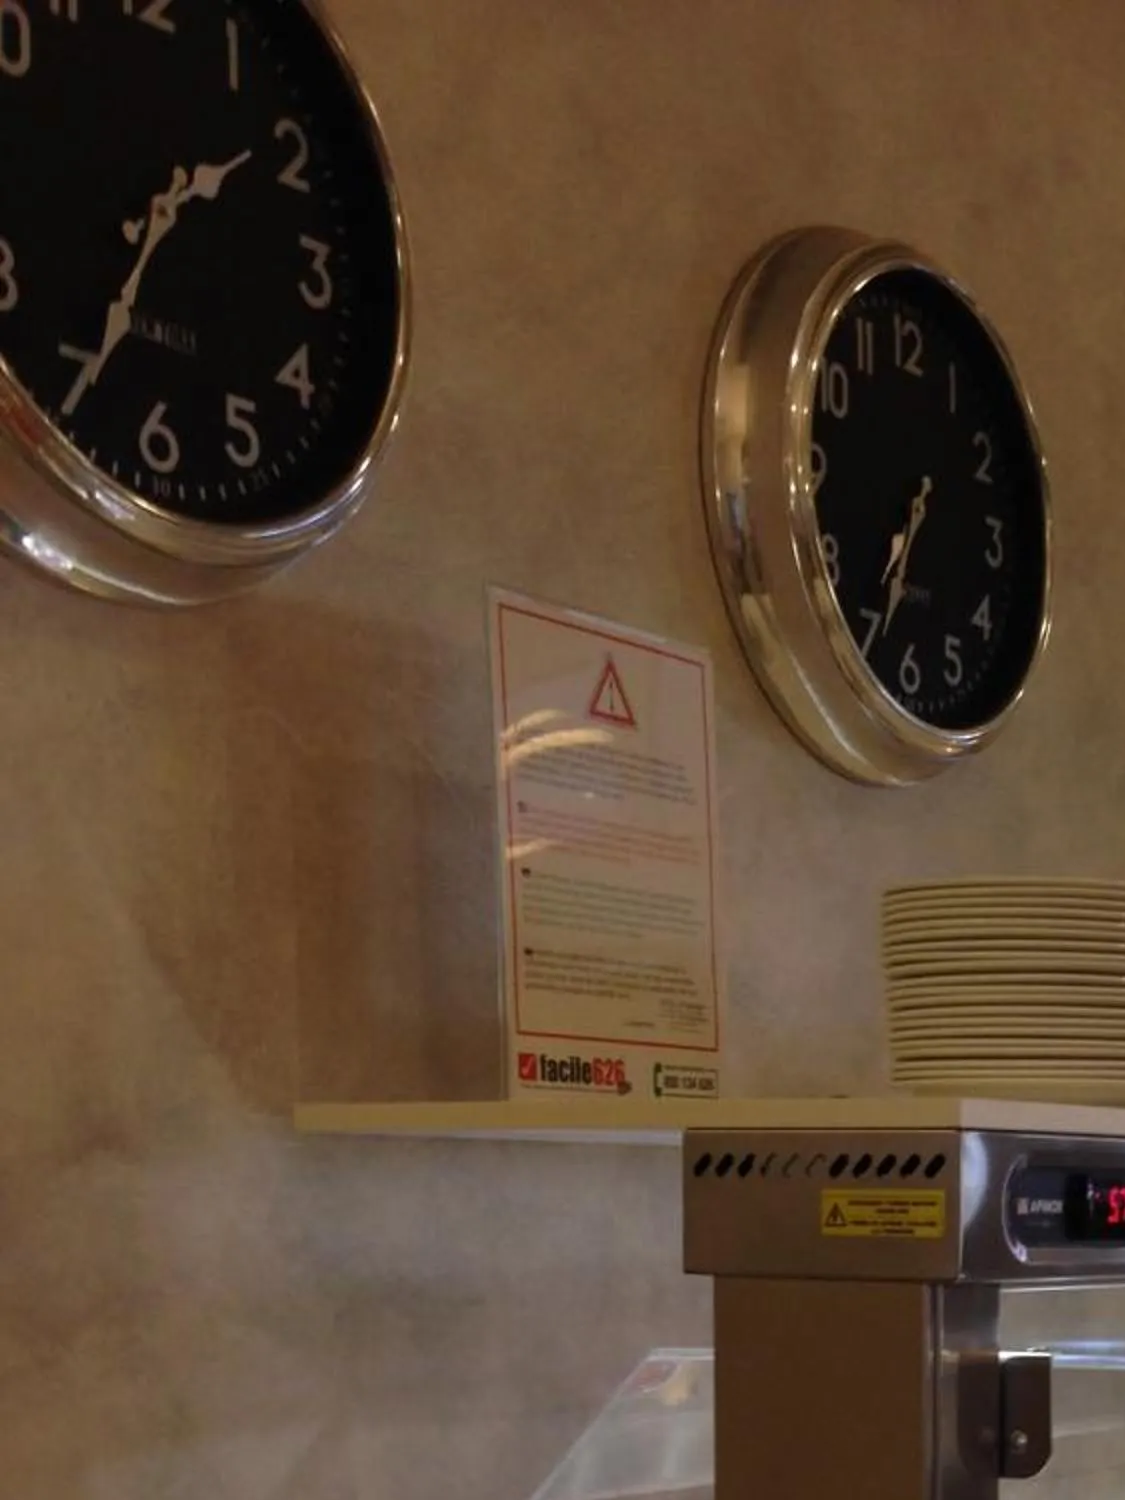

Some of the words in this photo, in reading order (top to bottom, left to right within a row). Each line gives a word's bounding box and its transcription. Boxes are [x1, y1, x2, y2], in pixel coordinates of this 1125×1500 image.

[225, 18, 239, 91] 1
[273, 118, 311, 193] 2
[298, 234, 333, 309] 3
[275, 343, 315, 409] 4
[855, 317, 875, 376] 11
[893, 314, 925, 377] 12
[58, 340, 99, 416] 7
[820, 357, 849, 420] 10
[947, 362, 957, 414] 1
[138, 400, 180, 473] 6
[224, 393, 260, 468] 5
[972, 431, 993, 483] 2
[984, 516, 1003, 569] 3
[859, 607, 882, 659] 7
[970, 594, 993, 642] 4
[899, 643, 921, 695] 6
[943, 634, 963, 688] 5
